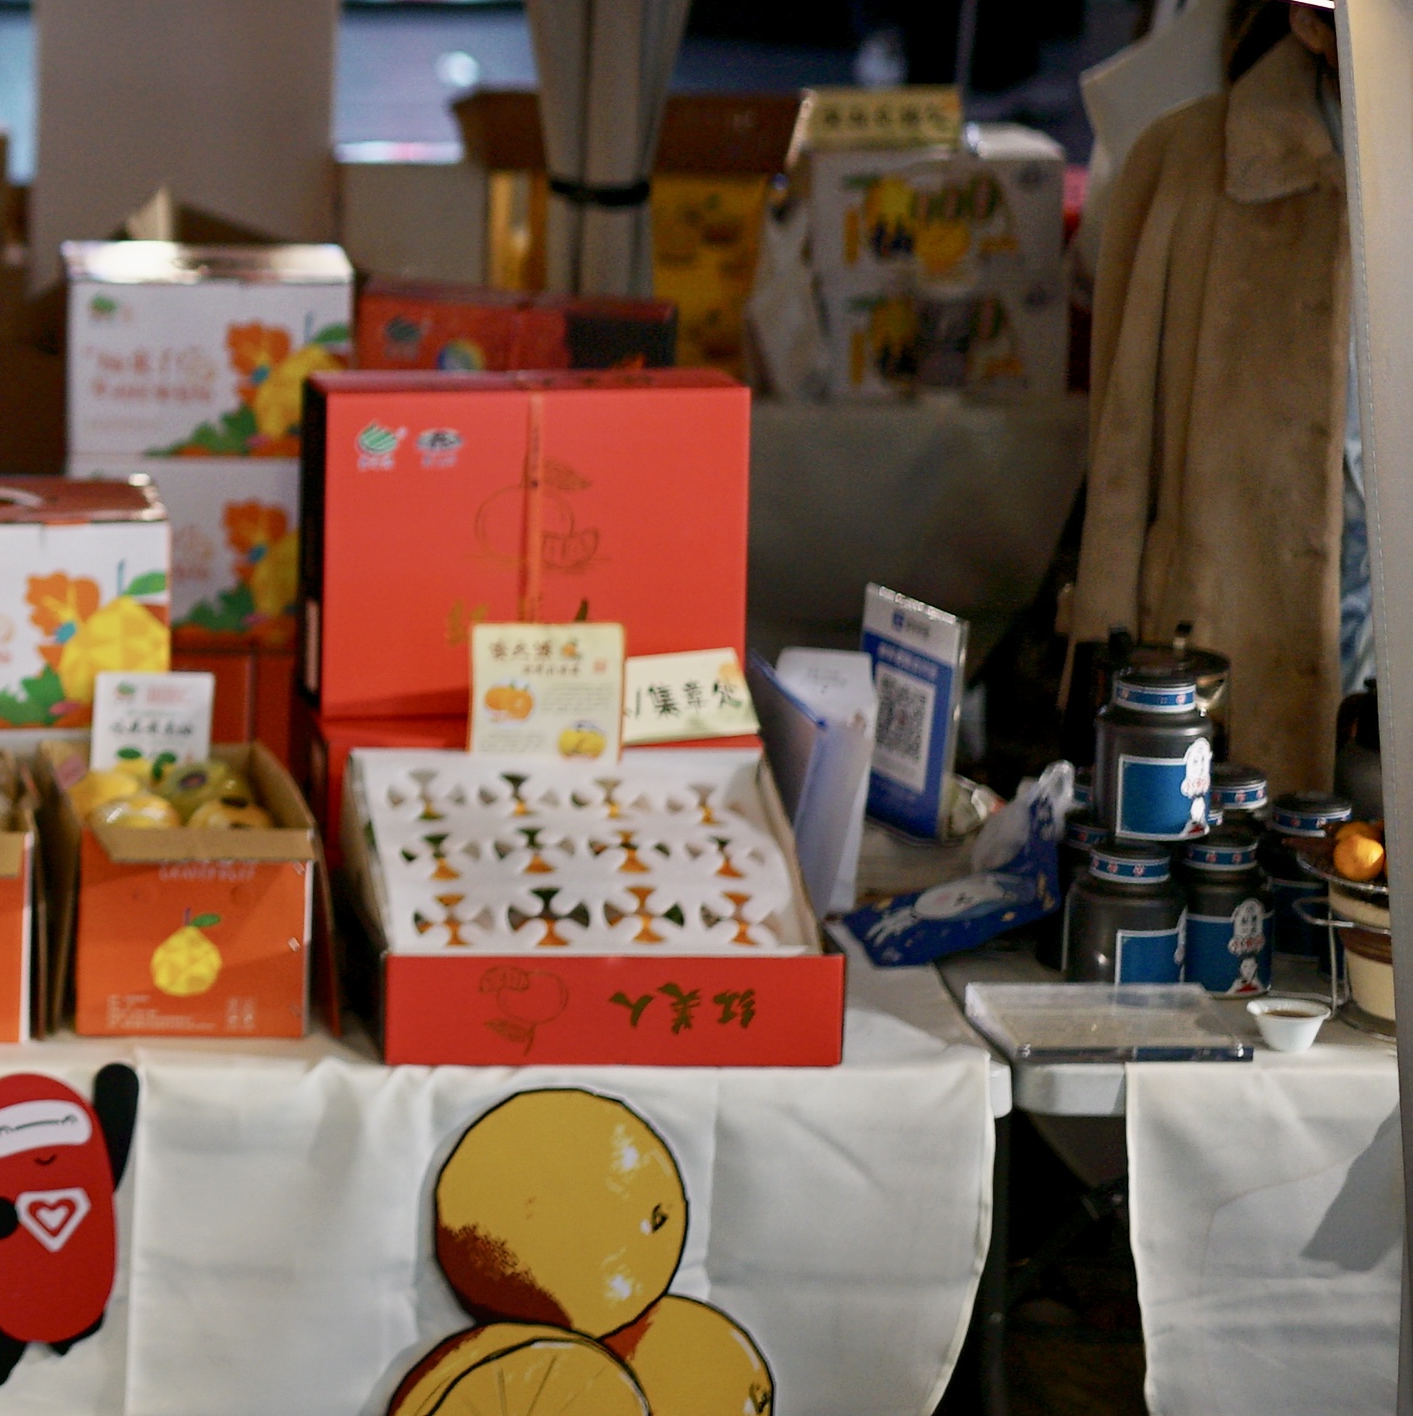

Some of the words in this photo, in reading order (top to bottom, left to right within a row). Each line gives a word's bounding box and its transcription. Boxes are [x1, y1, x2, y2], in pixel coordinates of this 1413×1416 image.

[626, 677, 742, 719] 集章处
[608, 980, 756, 1035] 红美人
